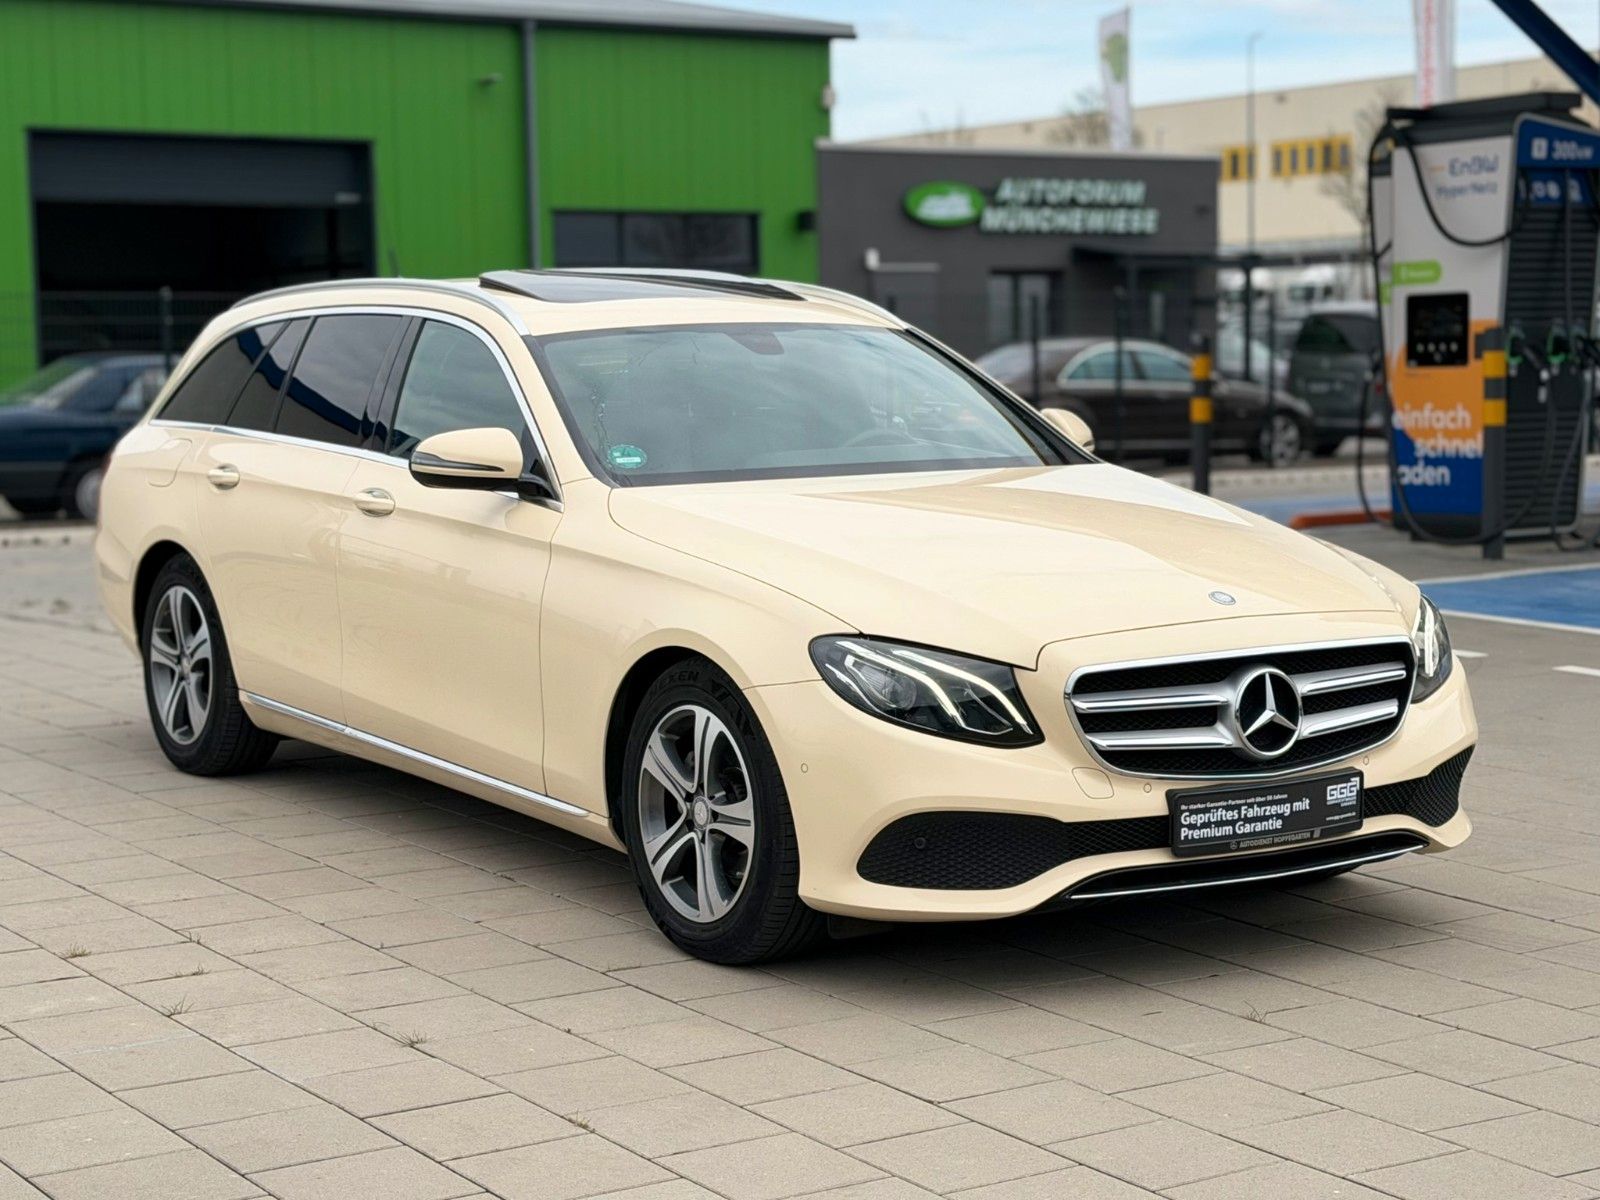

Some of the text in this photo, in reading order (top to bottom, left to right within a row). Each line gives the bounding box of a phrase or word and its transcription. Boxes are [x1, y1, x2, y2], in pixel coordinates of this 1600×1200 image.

[996, 178, 1147, 205] AUTOFORUM
[1391, 402, 1472, 430] einfach
[1413, 431, 1483, 459] schnel
[1398, 460, 1451, 486] aden
[1326, 782, 1358, 801] GGG
[1180, 807, 1239, 827] Geprüftes
[1240, 803, 1291, 819] Fahrzeug
[1292, 798, 1310, 812] mit
[1180, 818, 1283, 841] Premium Garantie
[1239, 832, 1311, 848] AUTODIENST HOPPEGARTEN
